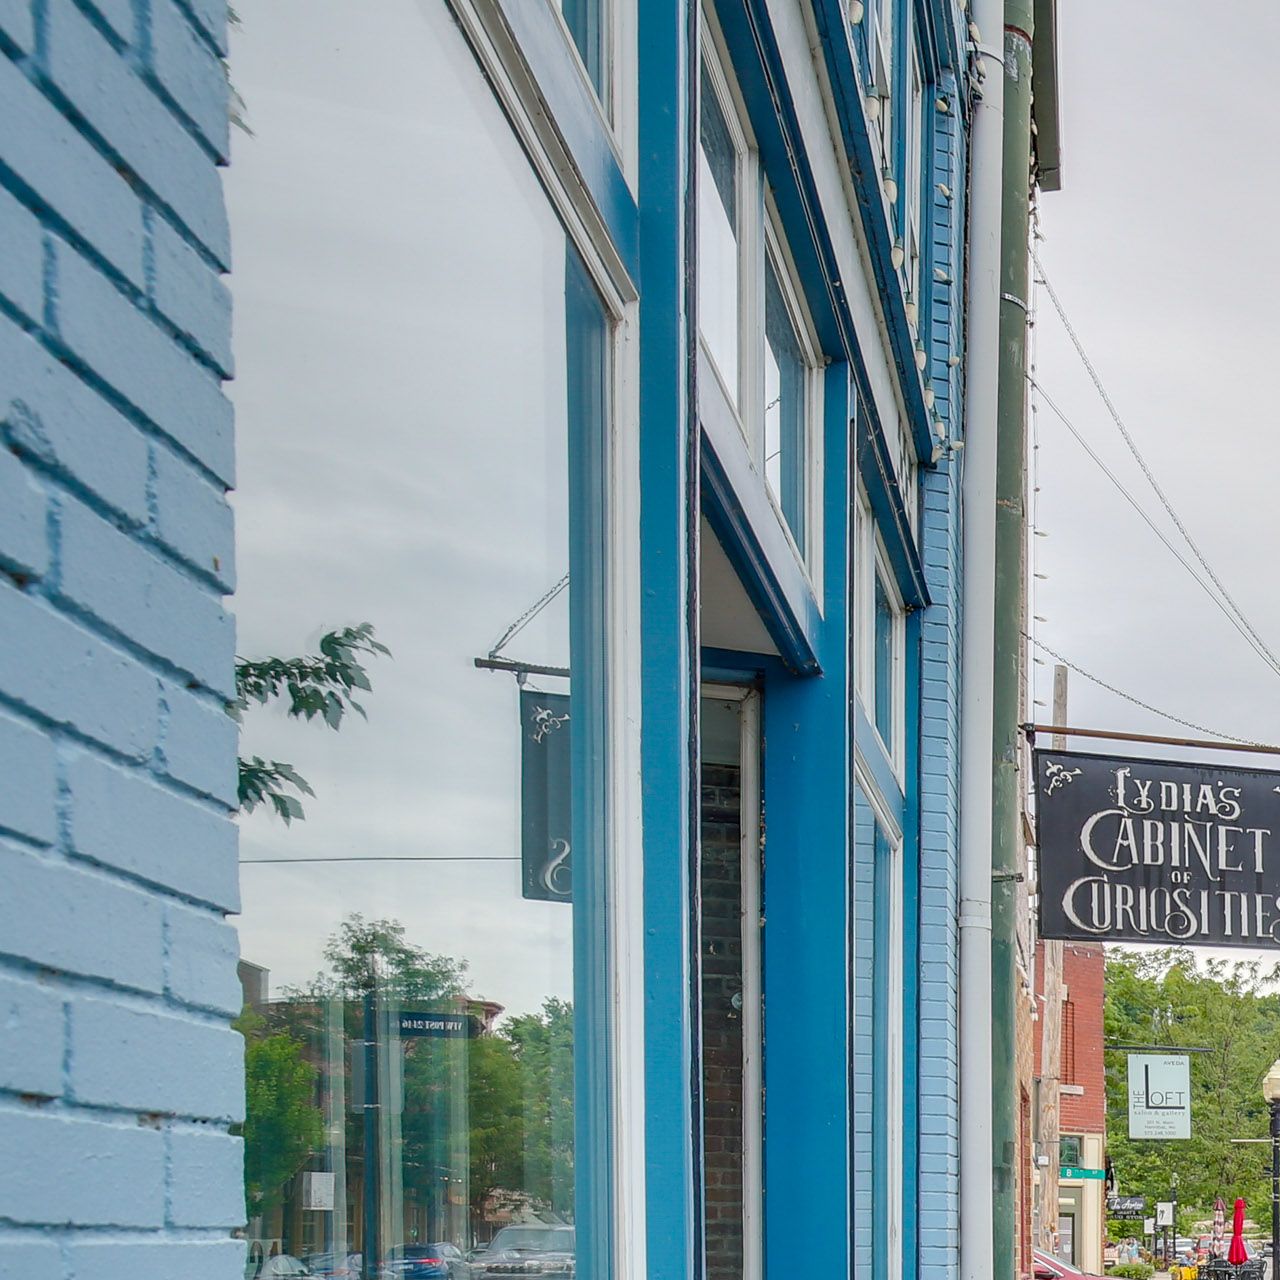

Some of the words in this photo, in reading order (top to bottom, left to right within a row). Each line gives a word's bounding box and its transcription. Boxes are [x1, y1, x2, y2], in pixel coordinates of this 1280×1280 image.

[1114, 767, 1242, 821] LYDIA'S
[1080, 808, 1271, 882] CABINET
[1171, 870, 1193, 884] OF
[1132, 1089, 1145, 1110] THE
[1144, 1063, 1186, 1110] LOFT
